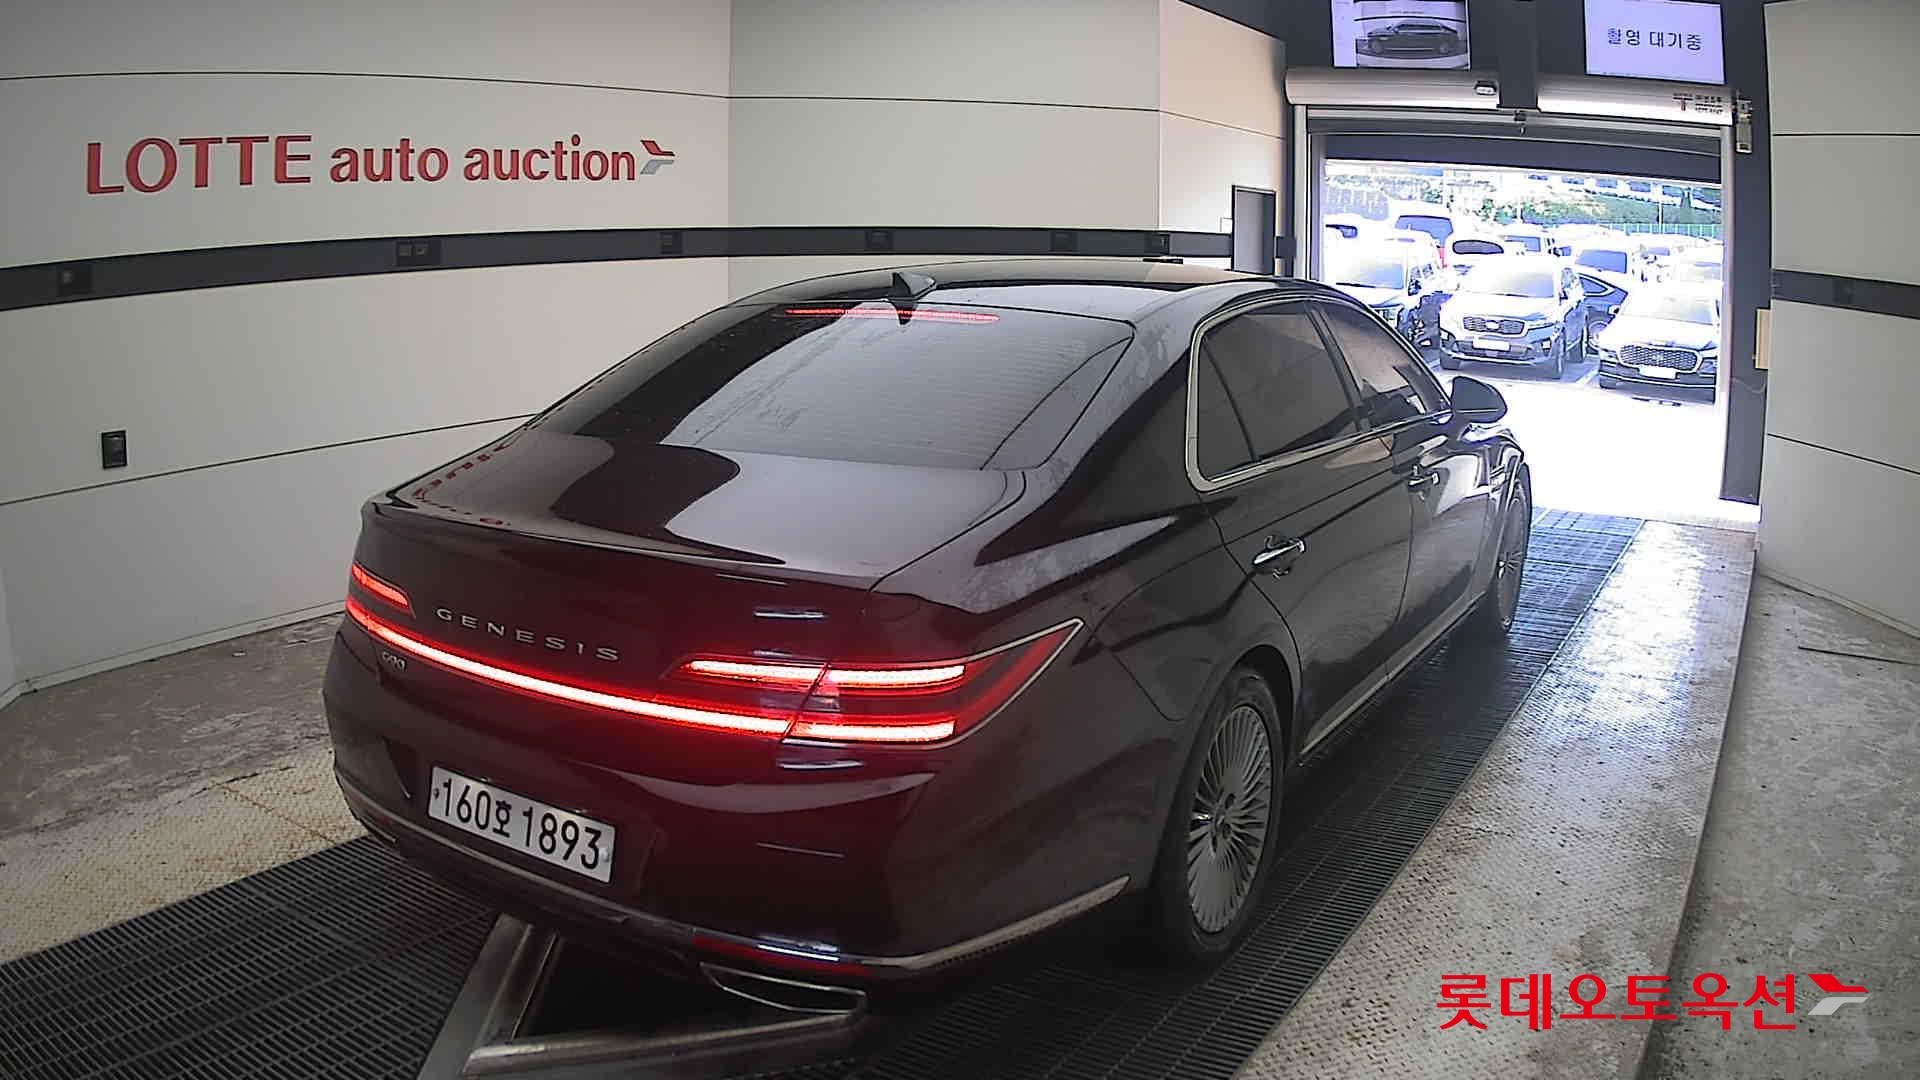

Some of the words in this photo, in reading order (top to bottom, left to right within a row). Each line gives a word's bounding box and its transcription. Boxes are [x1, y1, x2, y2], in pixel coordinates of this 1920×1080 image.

[1649, 31, 1702, 51] 대기중
[86, 135, 312, 194] LOTTE
[329, 138, 449, 183] auto
[463, 134, 637, 181] auction
[435, 606, 621, 662] GENESIS
[442, 777, 511, 838] 160호
[522, 806, 602, 870] 1893
